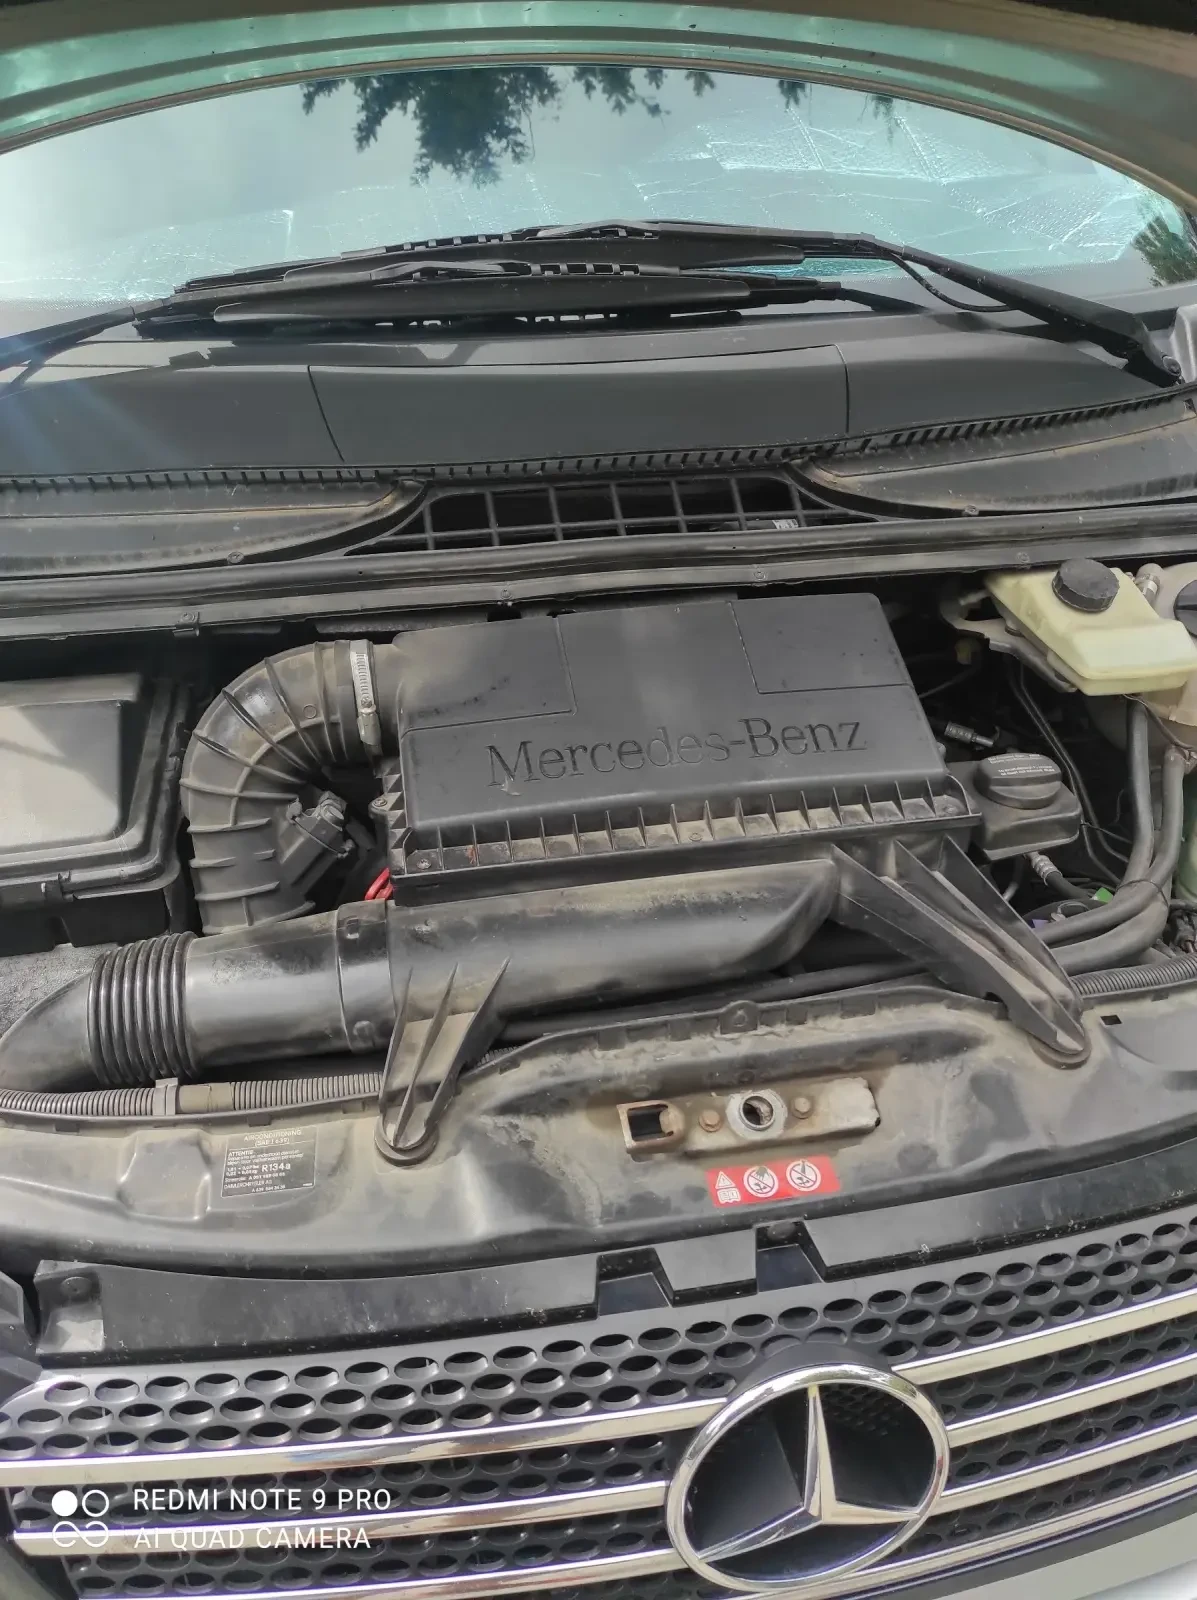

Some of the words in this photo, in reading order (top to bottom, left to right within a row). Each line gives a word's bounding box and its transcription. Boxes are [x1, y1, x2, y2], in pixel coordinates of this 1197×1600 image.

[484, 717, 868, 787] Mercedes-Benz
[244, 1130, 302, 1141] AIRCONDITIONING
[262, 1163, 291, 1172] R134a
